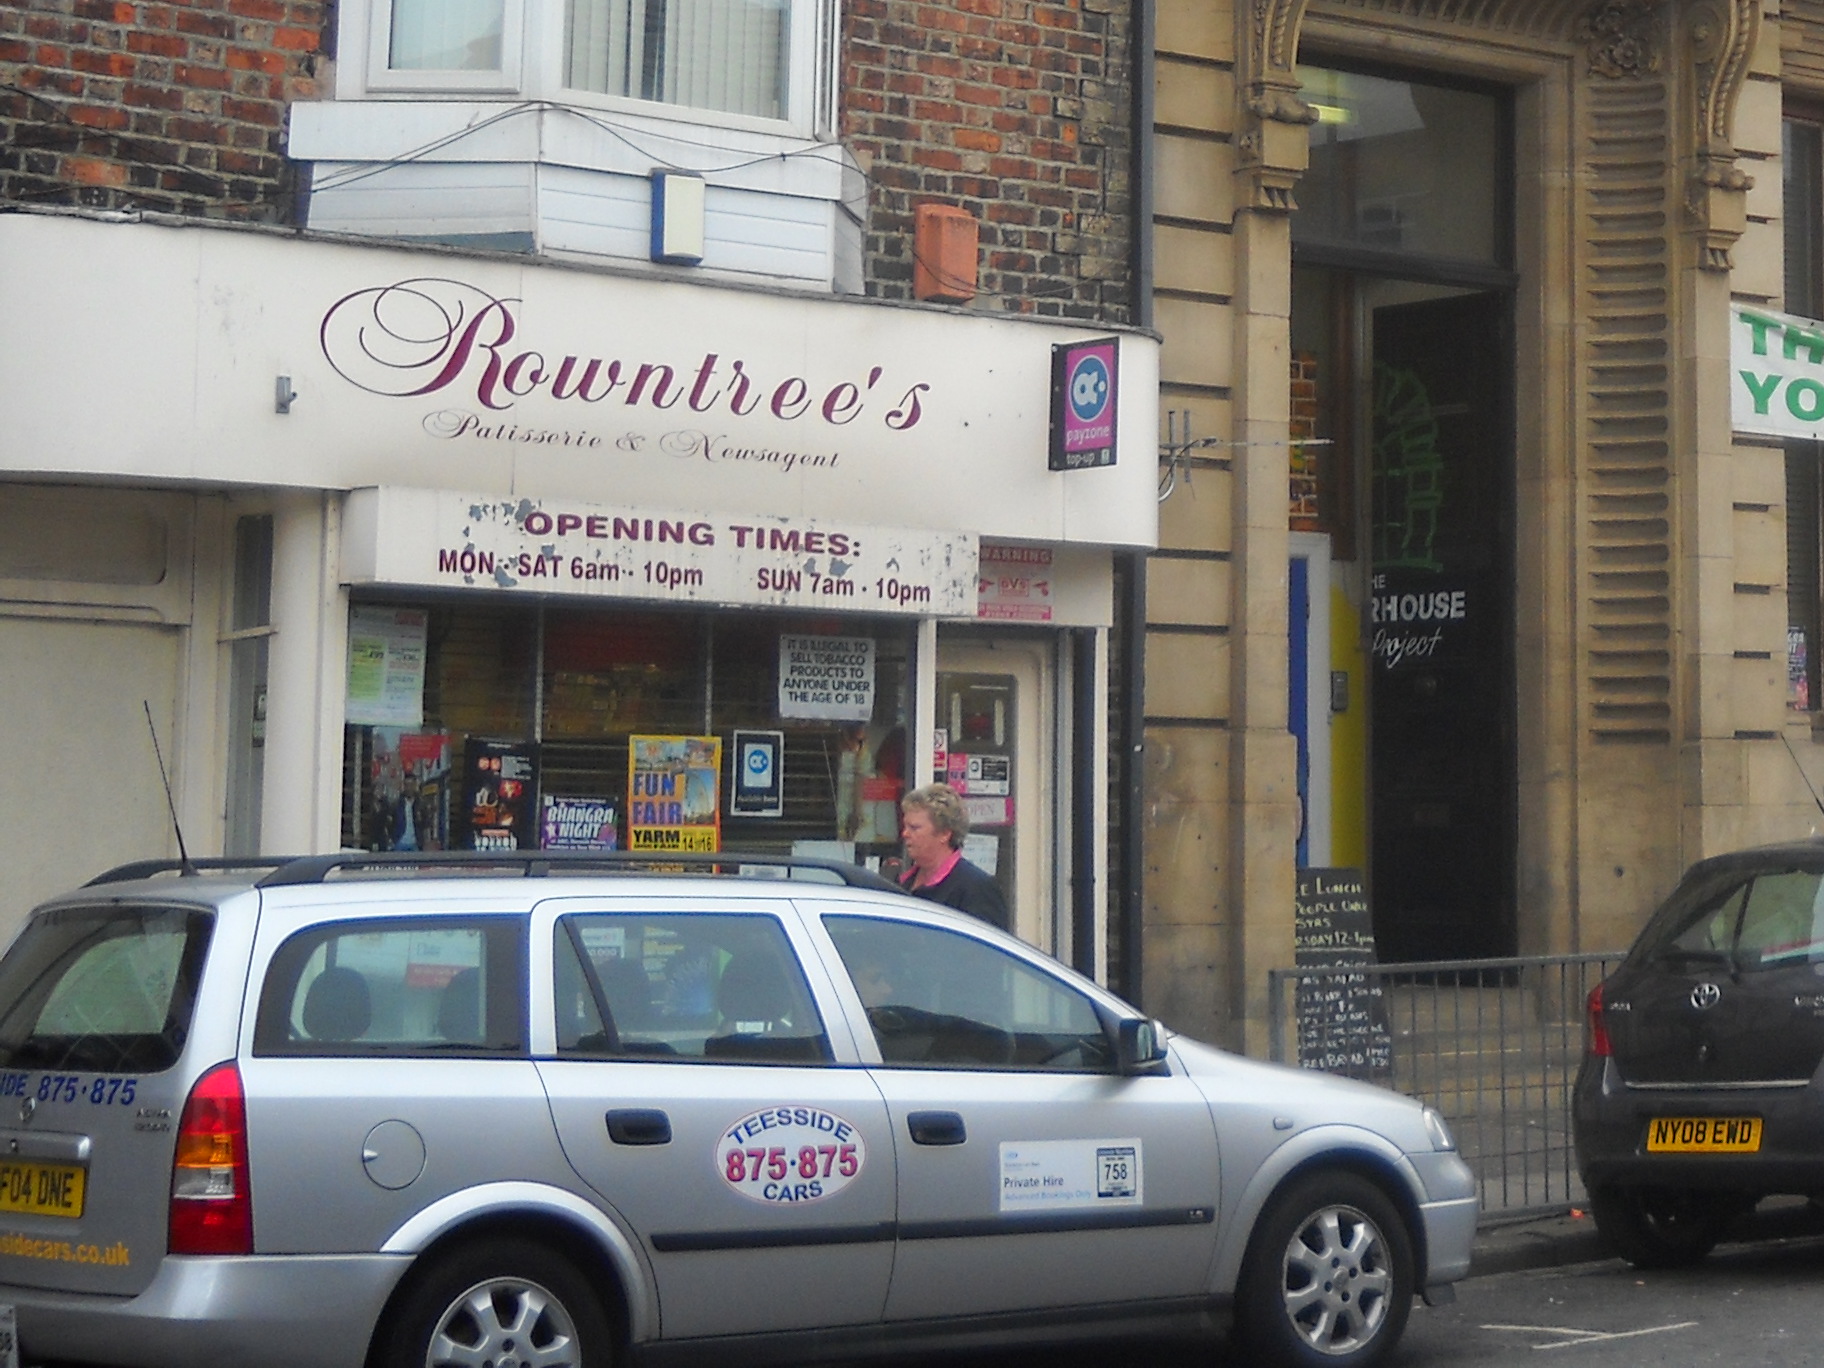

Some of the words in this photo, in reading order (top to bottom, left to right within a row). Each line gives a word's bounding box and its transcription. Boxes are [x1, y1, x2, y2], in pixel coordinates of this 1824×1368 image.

[320, 277, 931, 432] Rowntree's
[421, 410, 602, 451] Patisserie
[615, 431, 646, 452] &
[659, 429, 841, 473] Newsagent
[1066, 425, 1111, 447] payzone
[1066, 452, 1096, 467] top-up
[524, 511, 717, 546] OPENING
[729, 525, 861, 557] TIMES:
[439, 548, 495, 575] MON
[518, 552, 563, 579] SAT
[570, 556, 620, 582] 6am
[643, 560, 703, 591] 10pm
[757, 567, 801, 593] SUN
[809, 572, 855, 597] 7am
[875, 577, 931, 607] 10pm
[787, 638, 797, 650] IT
[799, 638, 809, 651] IS
[810, 639, 852, 652] ILLEGAL
[853, 641, 869, 654] TO
[790, 651, 812, 664] SELL
[814, 653, 866, 666] TOBACCO
[790, 665, 847, 679] PRODUCTS
[850, 666, 865, 680] TO
[783, 677, 829, 691] ANYONE
[832, 679, 871, 692] UNDER
[788, 691, 809, 703] THE
[811, 692, 833, 704] AGE
[834, 692, 851, 705] OF
[854, 693, 866, 705] 18
[633, 772, 677, 797] FUN
[547, 805, 615, 824] BHANGRA
[632, 800, 685, 826] FAIR
[559, 822, 602, 839] NIGHT
[633, 829, 681, 844] YARM
[683, 836, 694, 851] 14
[0, 1073, 29, 1097] IDE
[727, 1107, 853, 1145] TEESSIDE
[1654, 1120, 1707, 1145] NY08
[1711, 1119, 1753, 1145] EWD
[1004, 1177, 1040, 1189] Private
[1043, 1175, 1065, 1187] Hire
[1104, 1163, 1128, 1181] 758
[36, 1169, 75, 1209] DNE
[763, 1179, 824, 1203] CARS
